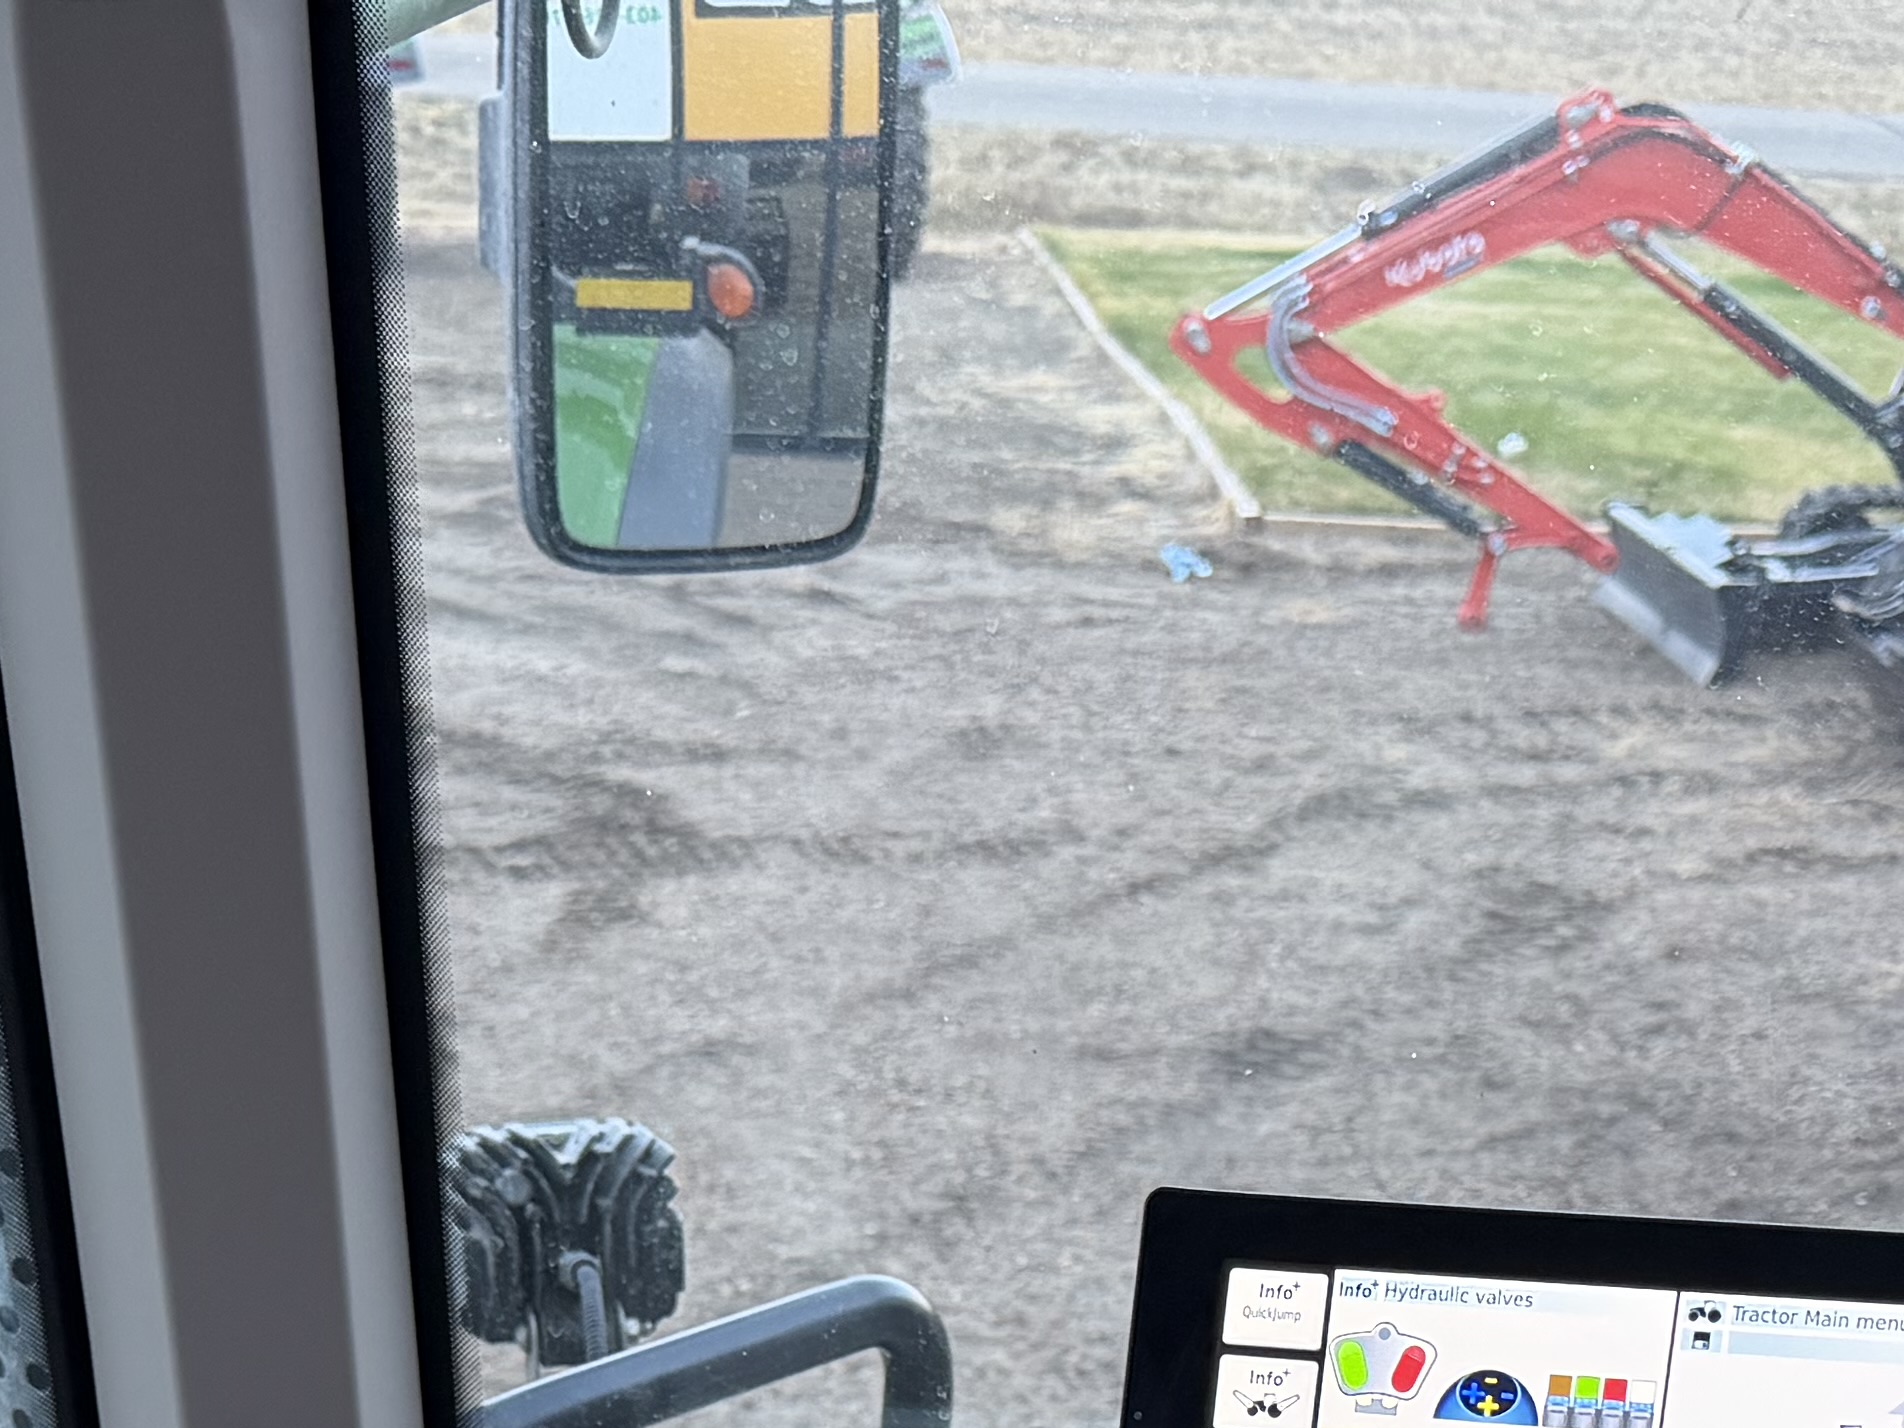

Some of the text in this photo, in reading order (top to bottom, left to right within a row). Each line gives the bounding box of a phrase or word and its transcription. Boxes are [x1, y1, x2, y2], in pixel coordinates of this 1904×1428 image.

[1385, 1281, 1469, 1304] Hydraulic
[1476, 1288, 1534, 1308] valves
[1732, 1304, 1798, 1326] Tractor
[1804, 1309, 1850, 1329] Main
